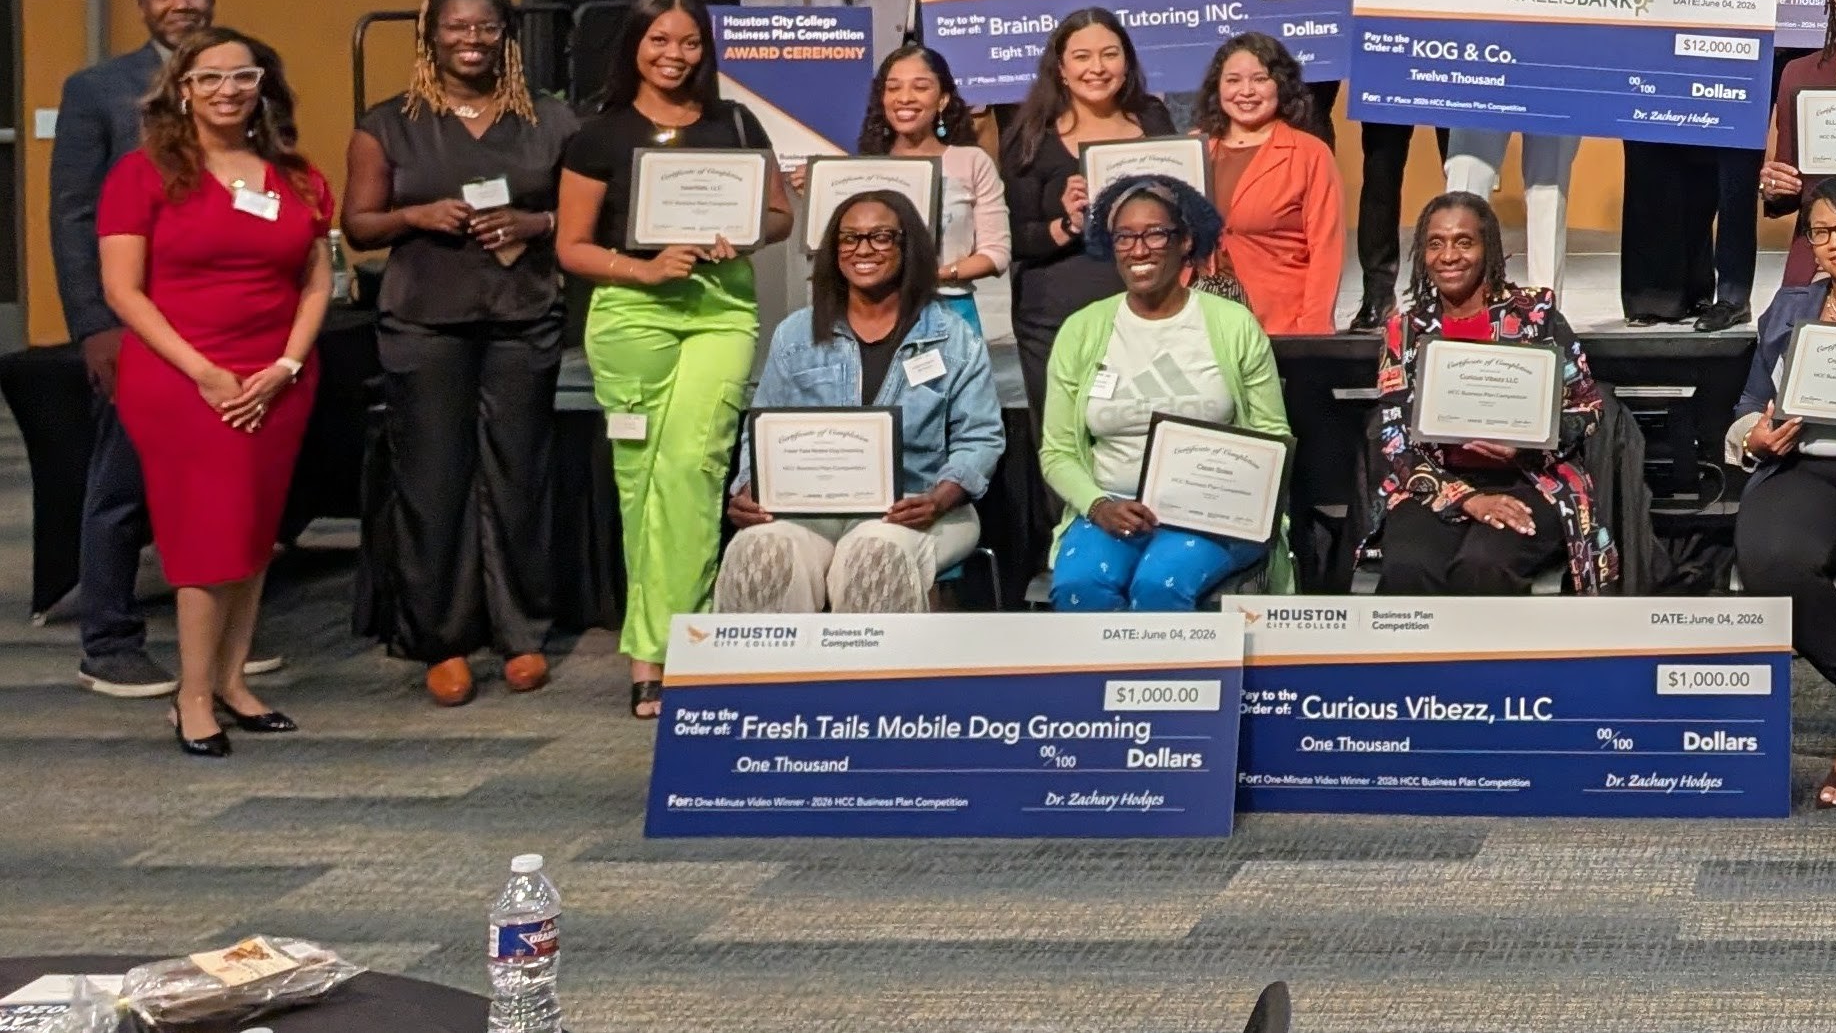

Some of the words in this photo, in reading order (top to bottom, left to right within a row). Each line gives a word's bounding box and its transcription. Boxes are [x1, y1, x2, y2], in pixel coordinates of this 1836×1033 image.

[723, 15, 769, 26] Houston
[772, 15, 793, 29] City
[796, 16, 837, 29] College
[1116, 7, 1199, 26] Tutoring
[1206, 3, 1249, 21] INC.
[724, 30, 769, 40] Business
[772, 29, 795, 39] Plan
[798, 30, 864, 42] Competition
[1283, 21, 1338, 37] Dollars
[724, 47, 779, 59] AWARD
[782, 47, 865, 59] CEREMONY
[991, 47, 1022, 60] Eight
[1412, 40, 1458, 59] KOG
[1464, 44, 1478, 61] &
[1485, 45, 1517, 63] Co.
[1684, 40, 1750, 54] $12,000.00
[1410, 69, 1448, 82] Twelve
[1451, 72, 1505, 86] Thousand
[1692, 83, 1746, 99] Dollars
[1267, 609, 1347, 621] HOUSTON
[1373, 611, 1410, 619] Business
[1415, 611, 1434, 619] Plan
[1651, 614, 1687, 624] DATE:
[1689, 614, 1714, 625] June
[1717, 614, 1733, 626] 04,
[1737, 614, 1764, 624] 2026
[716, 627, 797, 638] HOUSTON
[822, 628, 861, 637] Business
[865, 628, 884, 637] Plan
[1372, 621, 1429, 631] Competition
[1103, 629, 1139, 639] DATE:
[1142, 629, 1166, 640] June
[1170, 629, 1186, 640] 04,
[1190, 629, 1216, 639] 2026
[821, 639, 879, 649] Competition
[1669, 671, 1749, 688] $1,000.00
[1116, 686, 1199, 704] $1,000.00
[1302, 695, 1398, 719] Curious
[1406, 696, 1495, 724] Vibezz,
[1504, 696, 1553, 720] LLC
[742, 716, 808, 739] Fresh
[817, 716, 869, 739] Tails
[877, 715, 961, 739] Mobile
[969, 716, 1020, 744] Dog
[1028, 716, 1151, 744] Grooming
[1301, 736, 1333, 752] One
[1337, 736, 1410, 752] Thousand
[1684, 731, 1757, 751] Dollars
[737, 757, 770, 772] One
[775, 756, 849, 772] Thousand
[1127, 748, 1203, 767] Dollars
[1606, 773, 1625, 787] Dr.
[1628, 772, 1677, 793] Zachary
[1680, 772, 1722, 793] Hodges
[1045, 792, 1064, 806] Dr.
[1068, 790, 1120, 812] Zachary
[1122, 790, 1164, 811] Hodges
